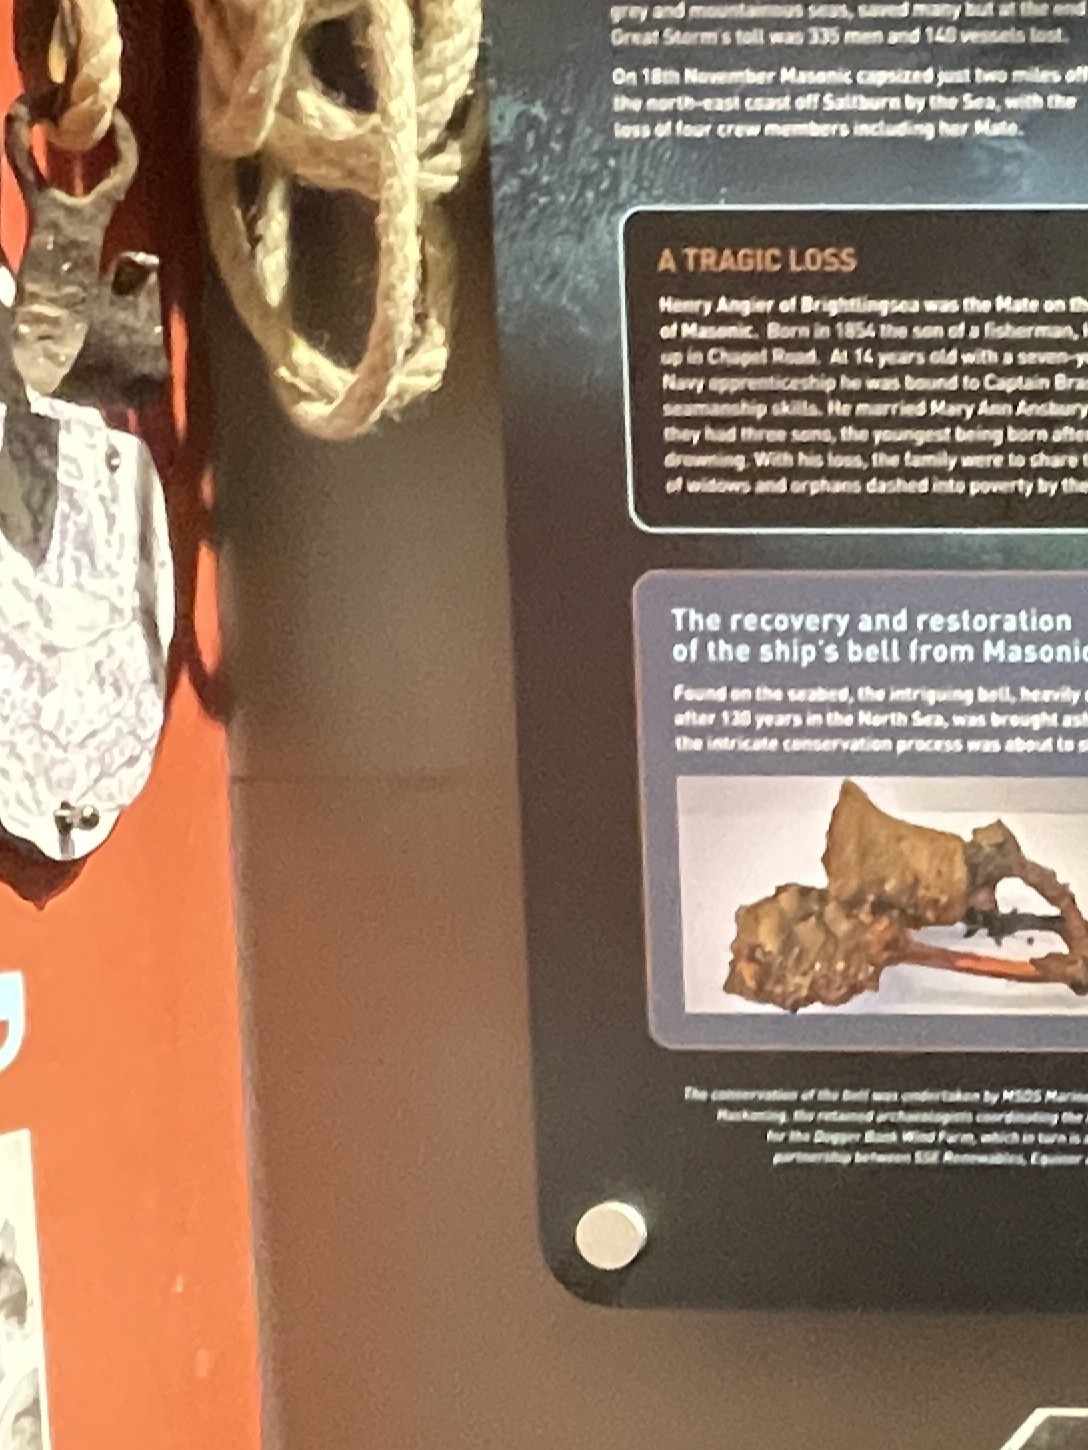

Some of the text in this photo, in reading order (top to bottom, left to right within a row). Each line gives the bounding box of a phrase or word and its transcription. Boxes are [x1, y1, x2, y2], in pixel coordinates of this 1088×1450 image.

[659, 248, 857, 272] A TRAGIC LOSS
[671, 608, 1071, 637] The recovery and restoration
[673, 638, 697, 661] of
[707, 638, 749, 661] the
[761, 639, 838, 667] ship's
[848, 639, 899, 662] bell
[909, 639, 973, 662] from
